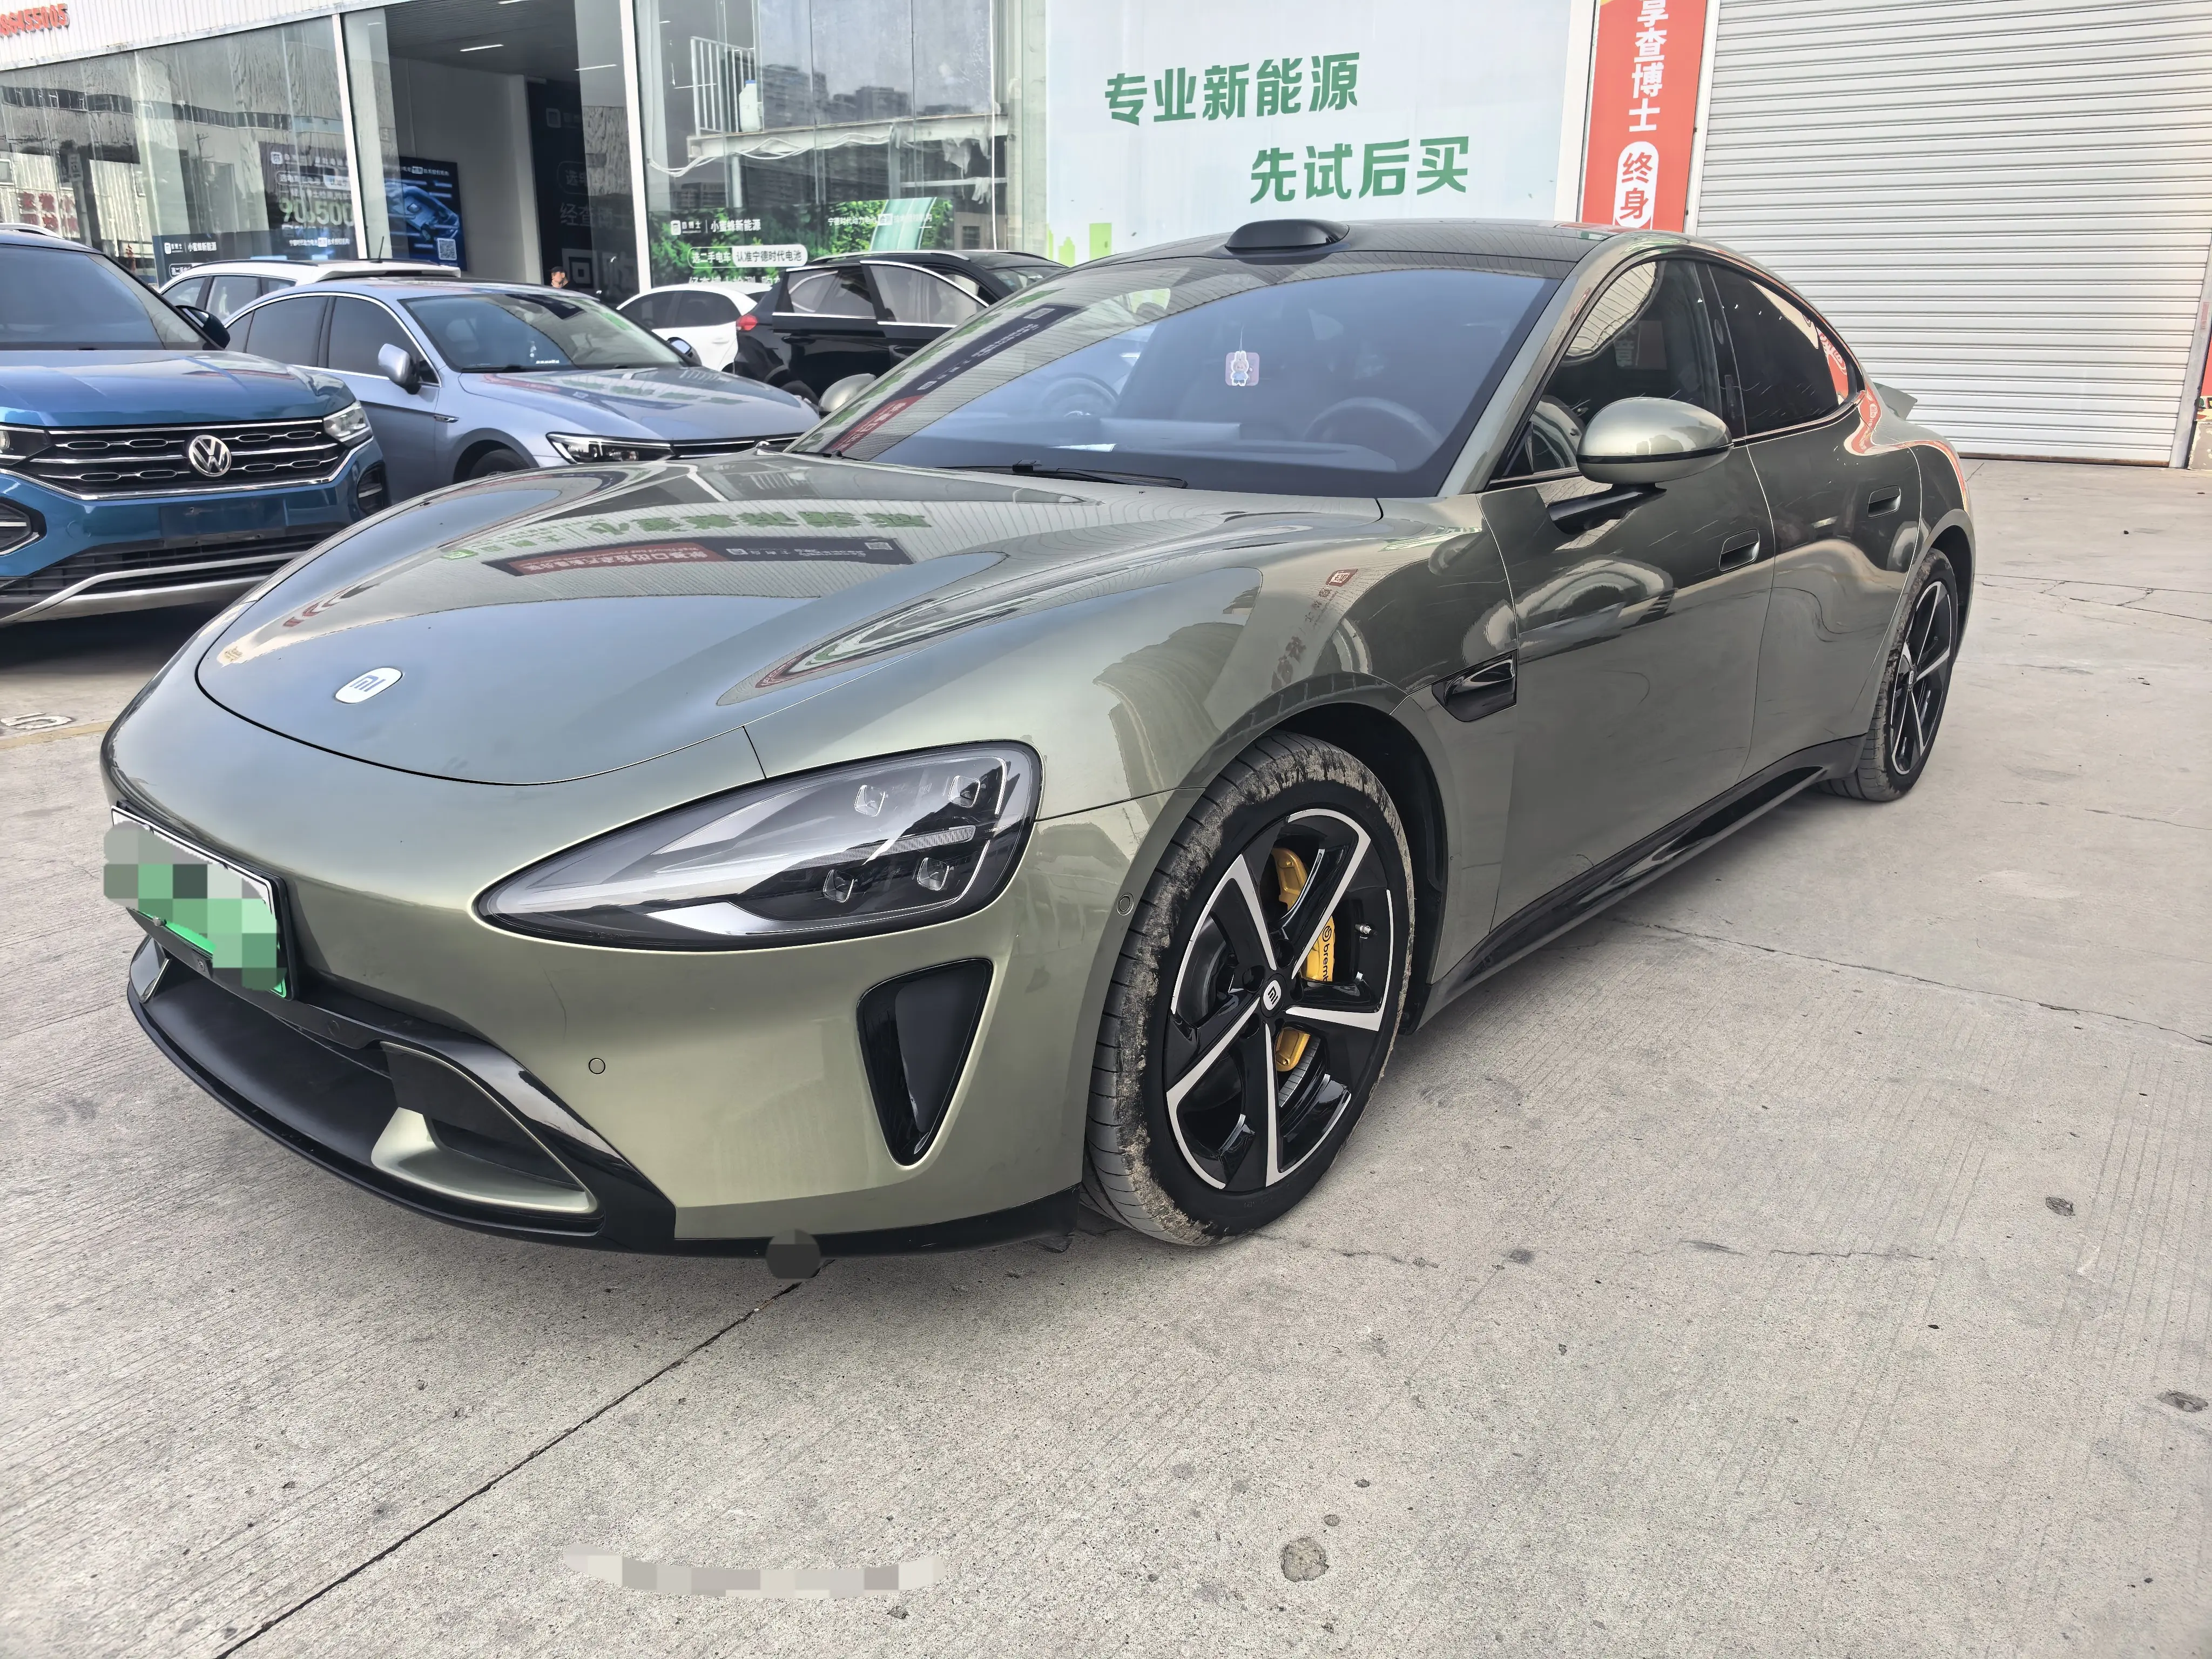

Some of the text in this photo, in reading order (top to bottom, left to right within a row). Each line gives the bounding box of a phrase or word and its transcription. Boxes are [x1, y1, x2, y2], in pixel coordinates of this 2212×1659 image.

[1105, 52, 1360, 126] 专业新能源
[1620, 0, 1669, 220] 享查博士 终身
[1250, 136, 1469, 204] 先试后买
[736, 250, 802, 262] 认准宁德时代电池
